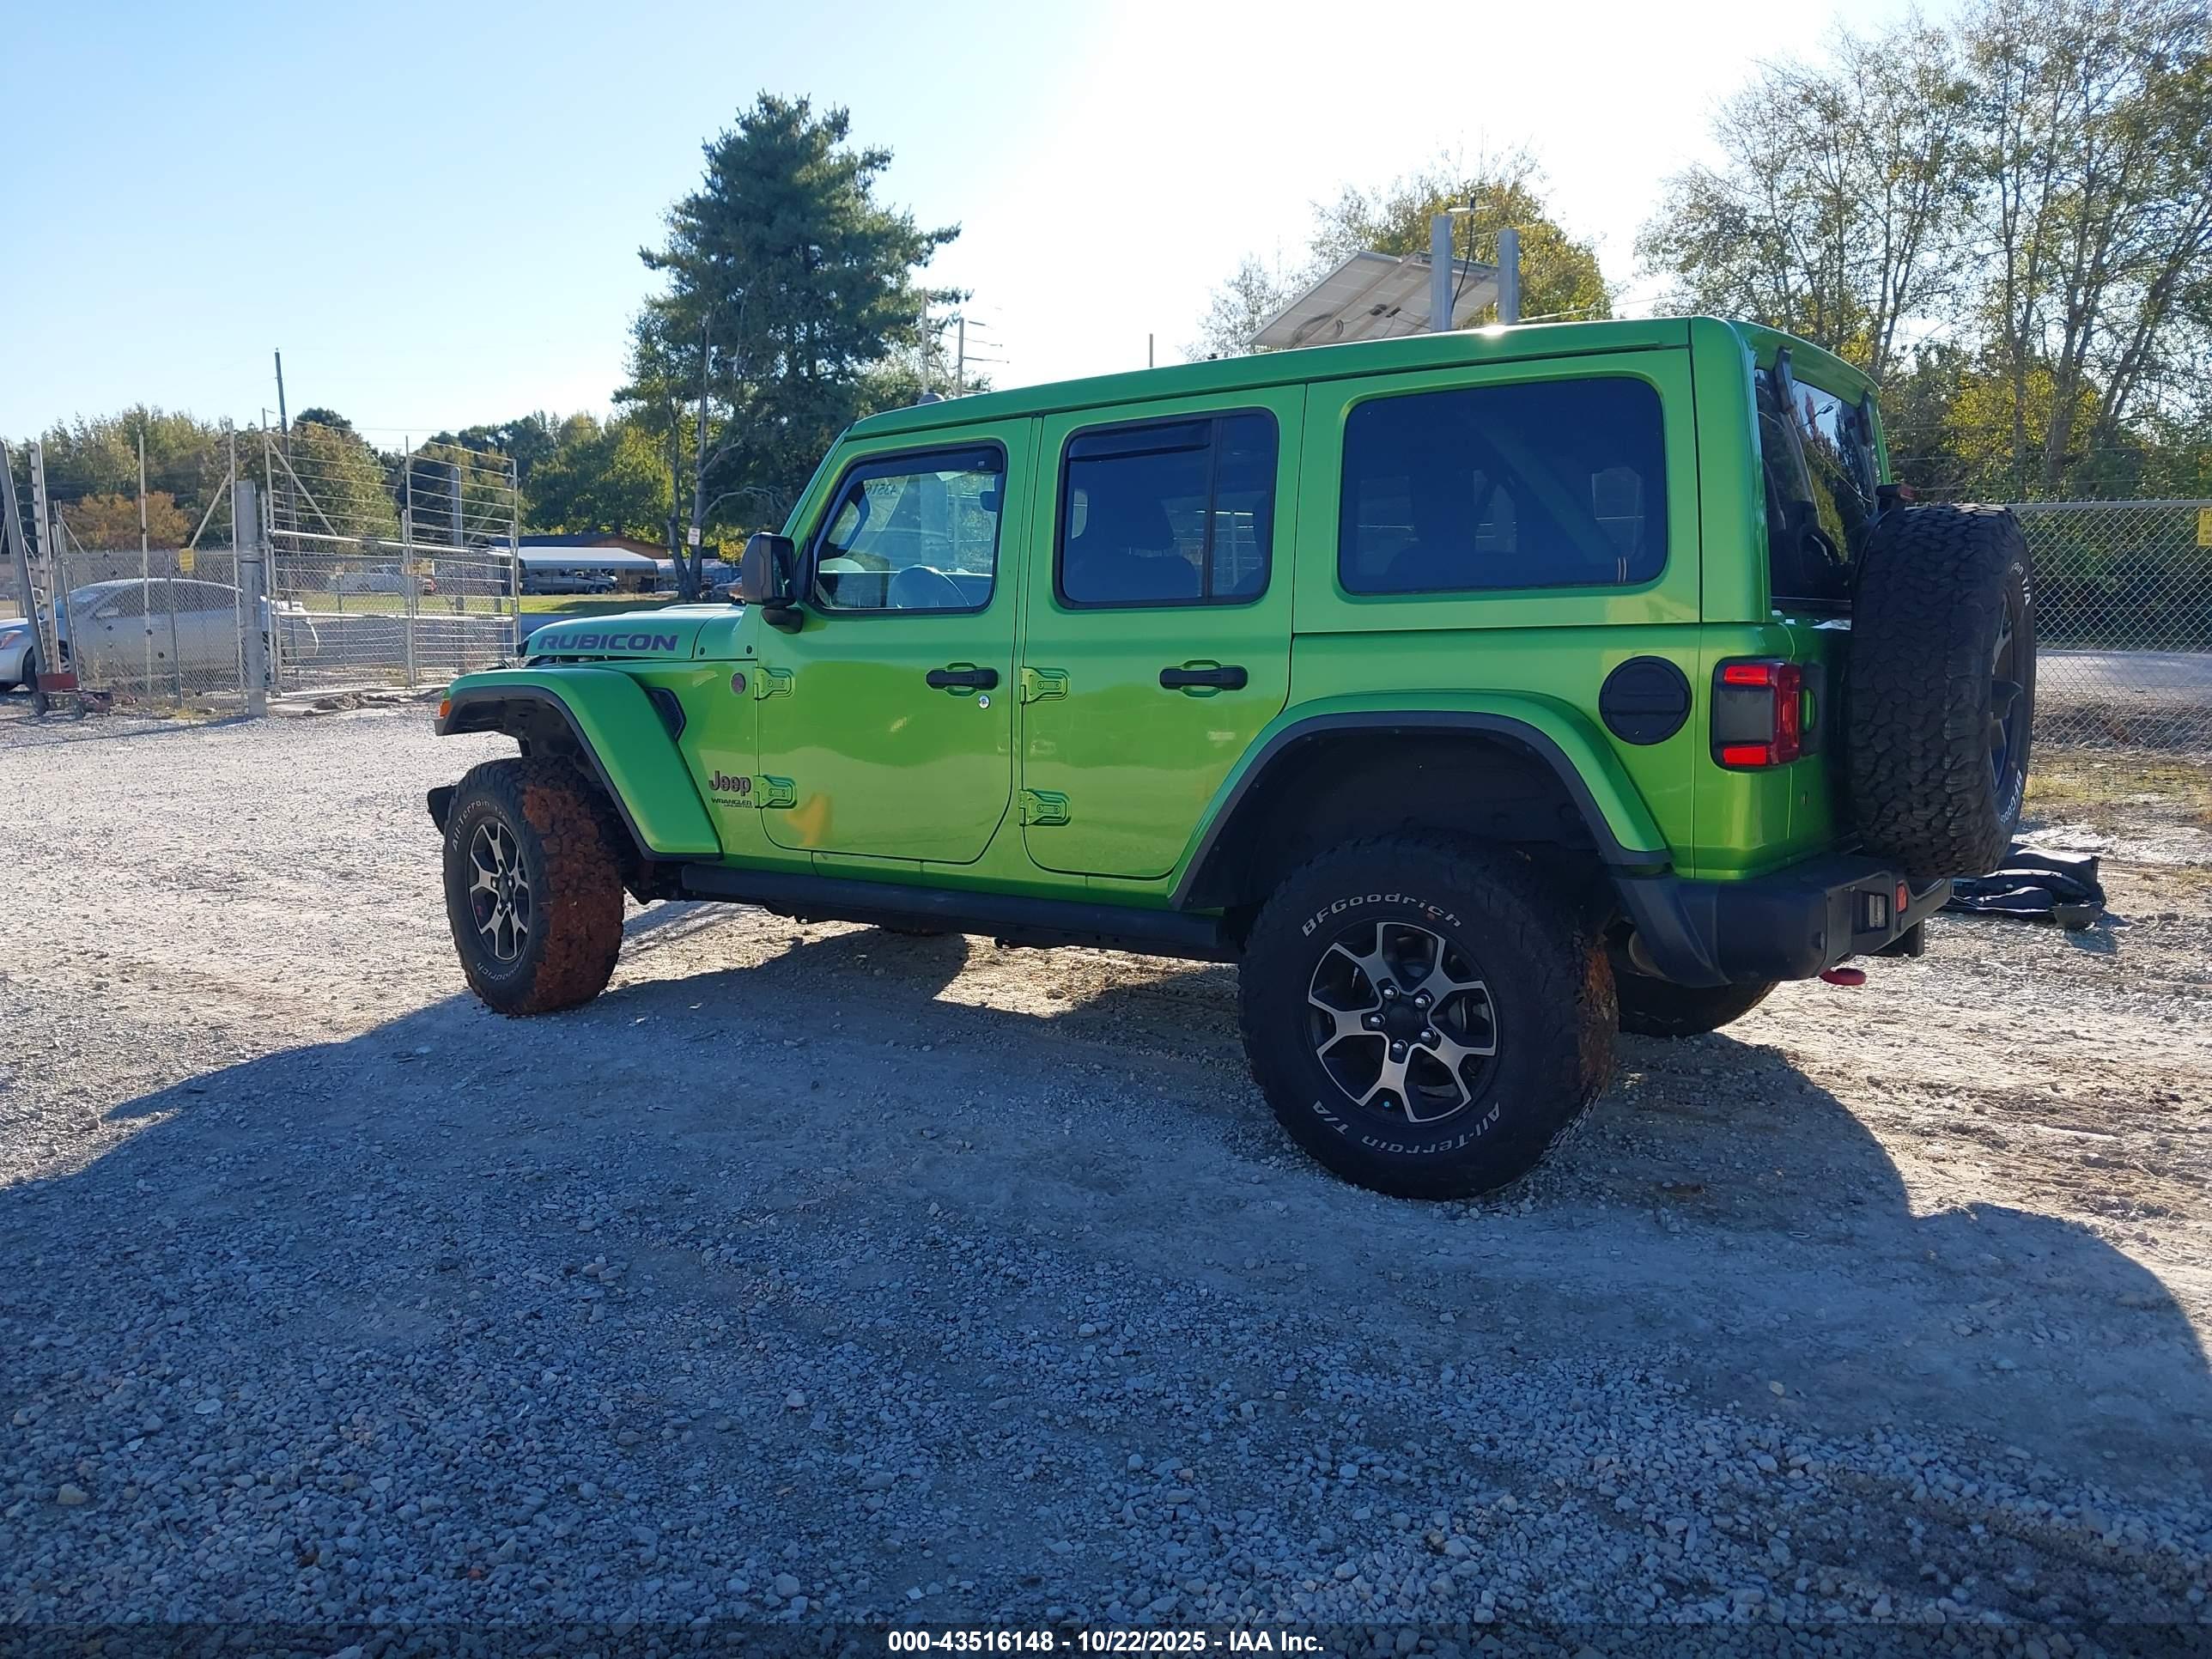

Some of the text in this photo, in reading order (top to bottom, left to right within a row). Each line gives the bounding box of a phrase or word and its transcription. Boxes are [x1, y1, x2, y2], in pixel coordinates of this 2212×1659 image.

[538, 634, 678, 652] RUBICON
[708, 769, 751, 797] Jeep
[453, 799, 490, 853] All-Terrain
[1302, 892, 1462, 937] BFGoodrich
[1312, 1100, 1501, 1154] All-Terrain T/A
